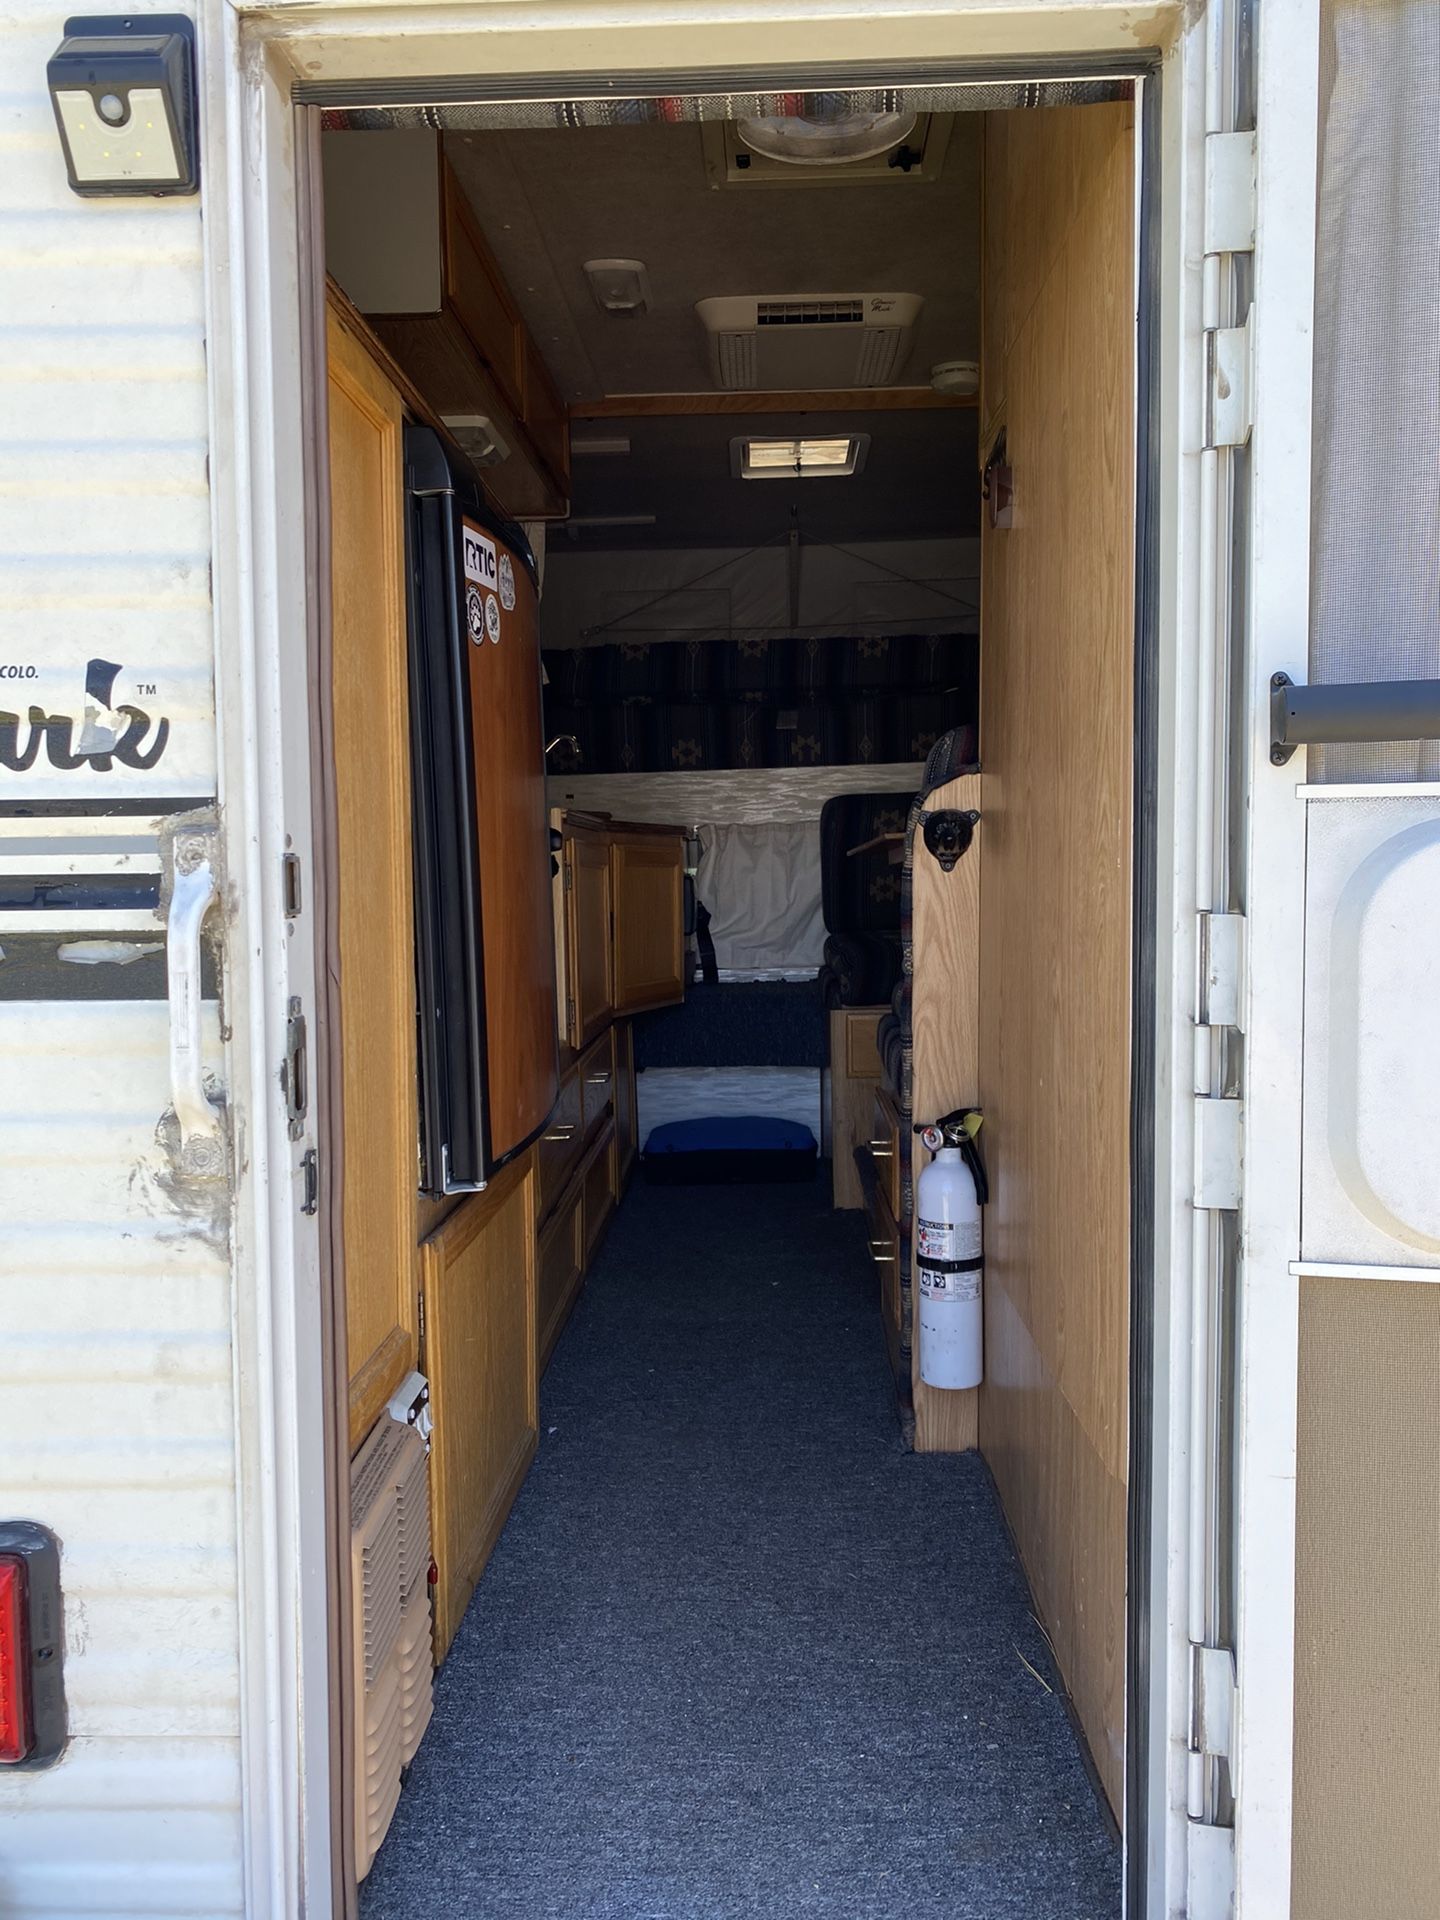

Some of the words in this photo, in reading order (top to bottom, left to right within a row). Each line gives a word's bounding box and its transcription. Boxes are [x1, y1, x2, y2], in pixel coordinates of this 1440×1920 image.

[465, 538, 495, 578] RTIC
[0, 665, 39, 679] COLO.
[137, 685, 157, 695] TM
